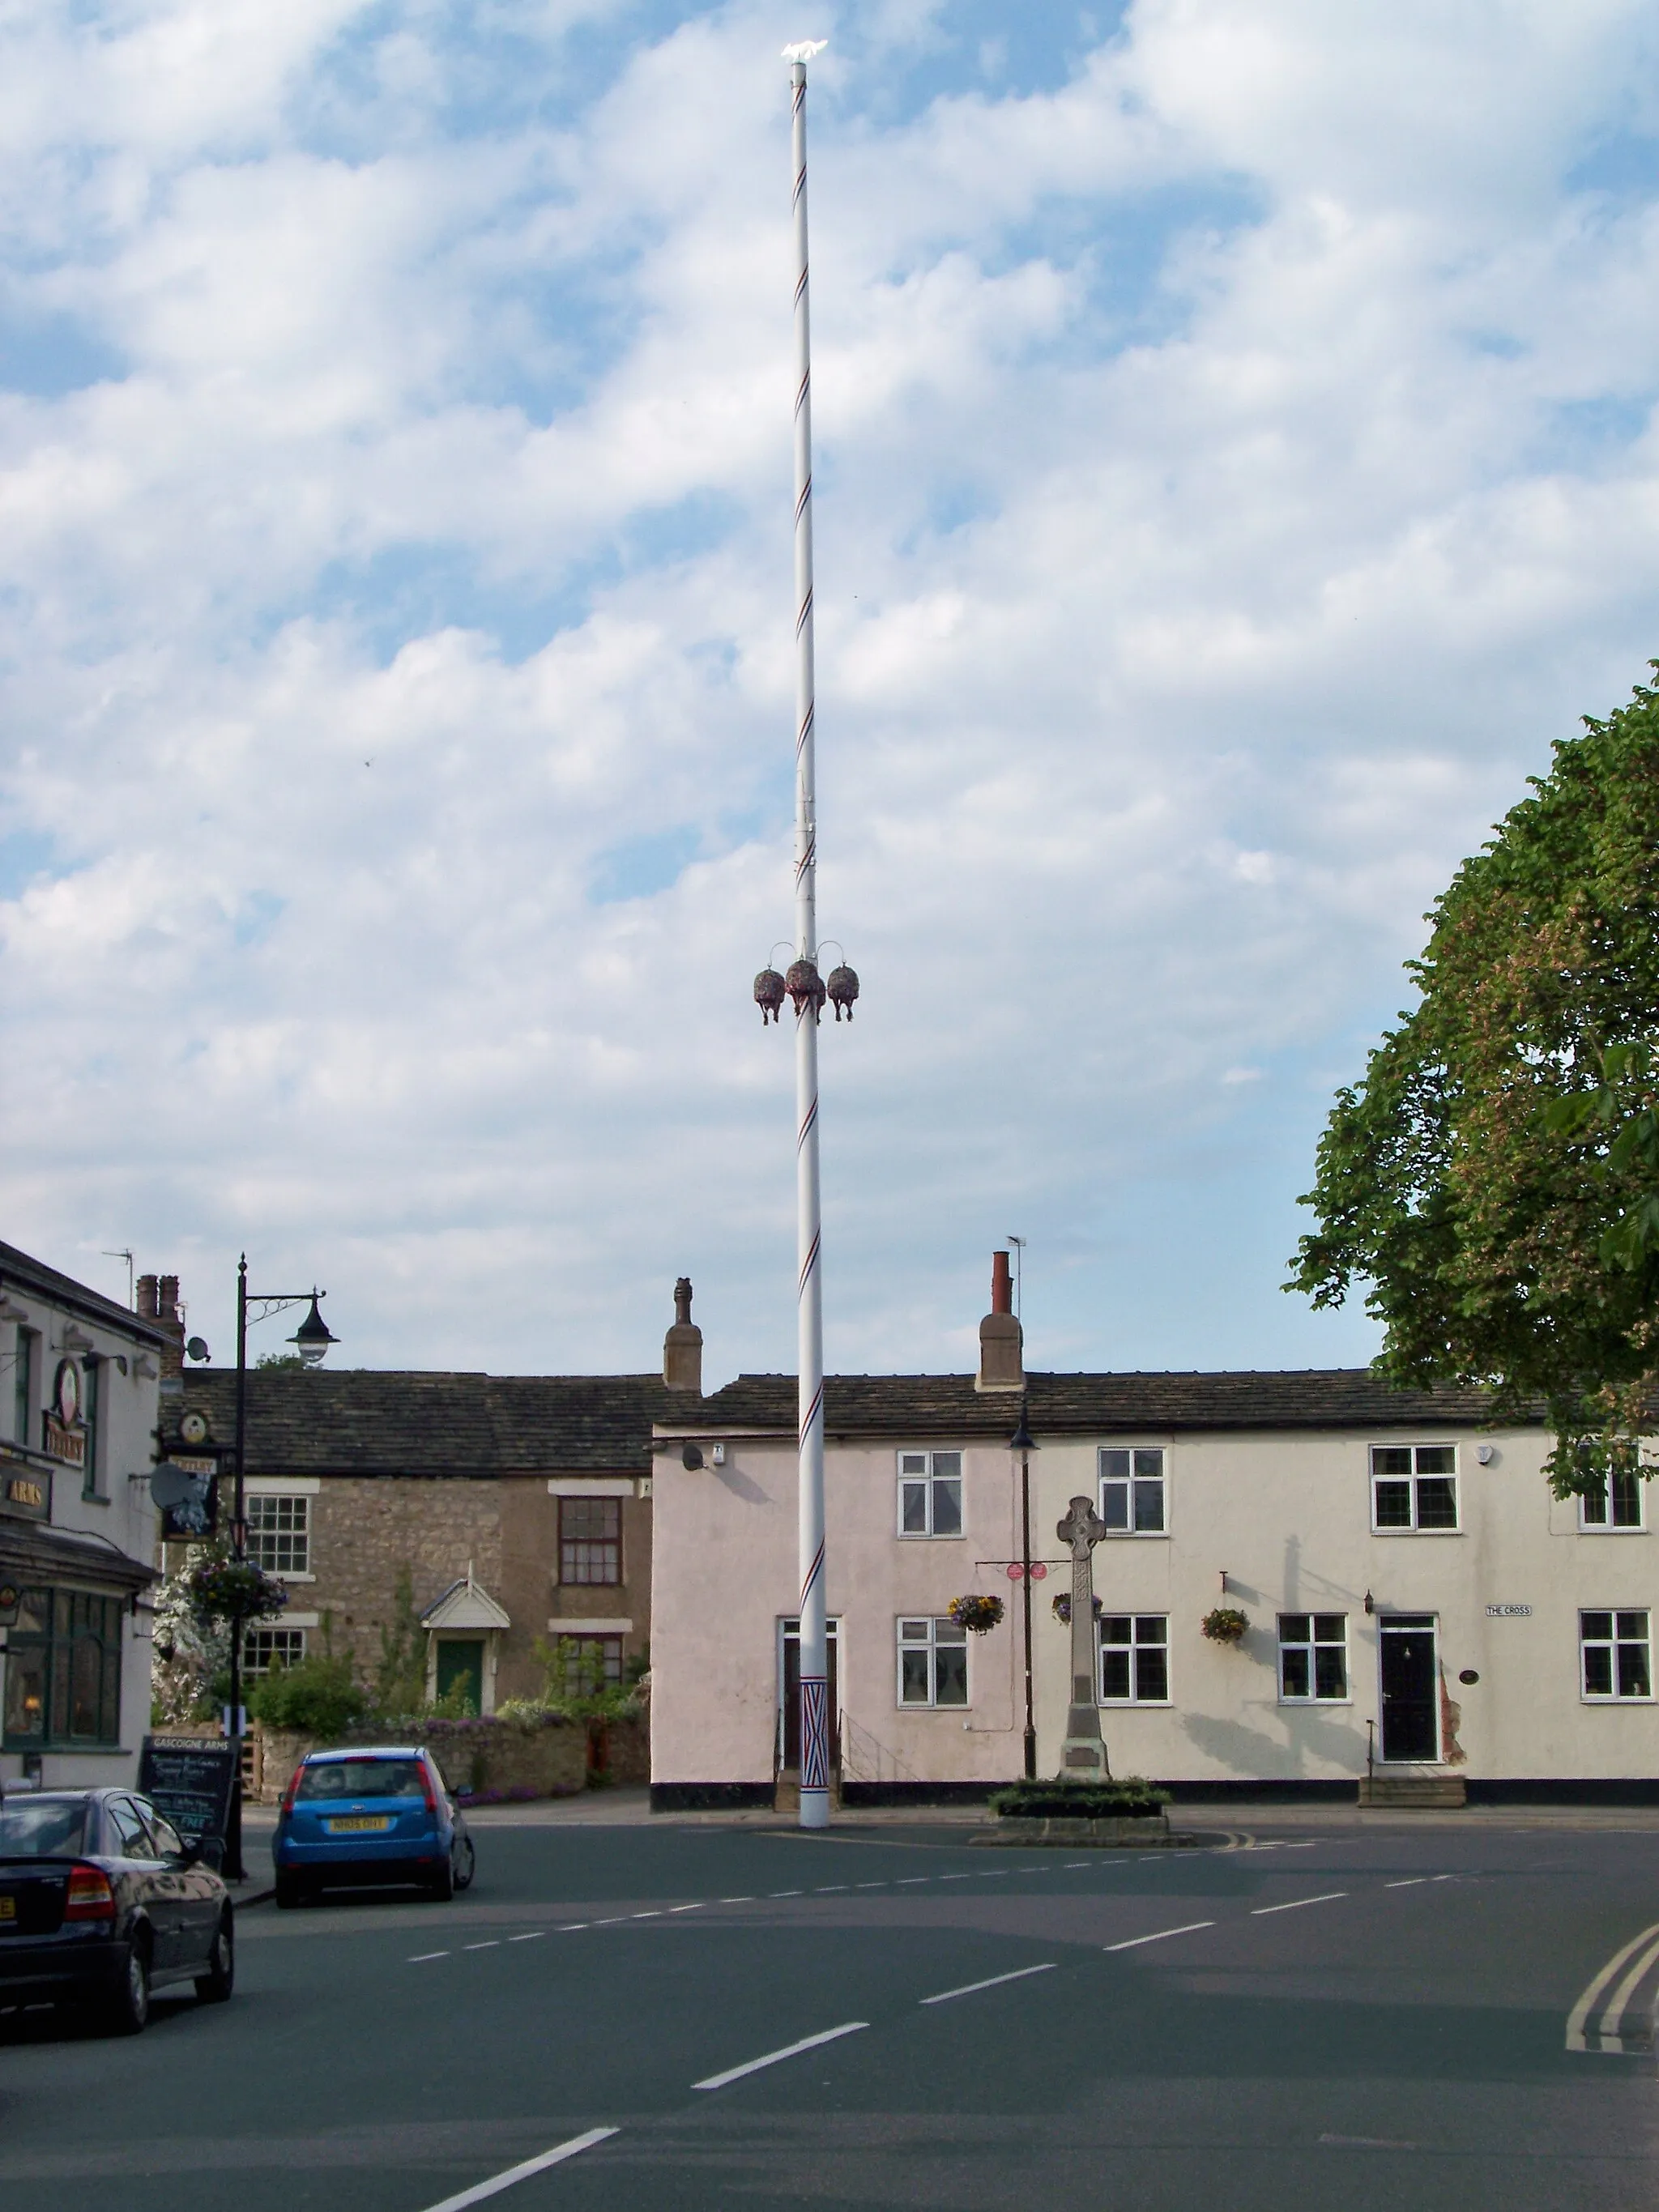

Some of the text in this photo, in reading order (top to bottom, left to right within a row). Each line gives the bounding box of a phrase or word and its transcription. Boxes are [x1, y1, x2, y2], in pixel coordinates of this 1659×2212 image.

[10, 1479, 41, 1507] ARMS
[1487, 1606, 1529, 1614] THE CROSS
[154, 1737, 229, 1750] GASCOIGNE ARMS
